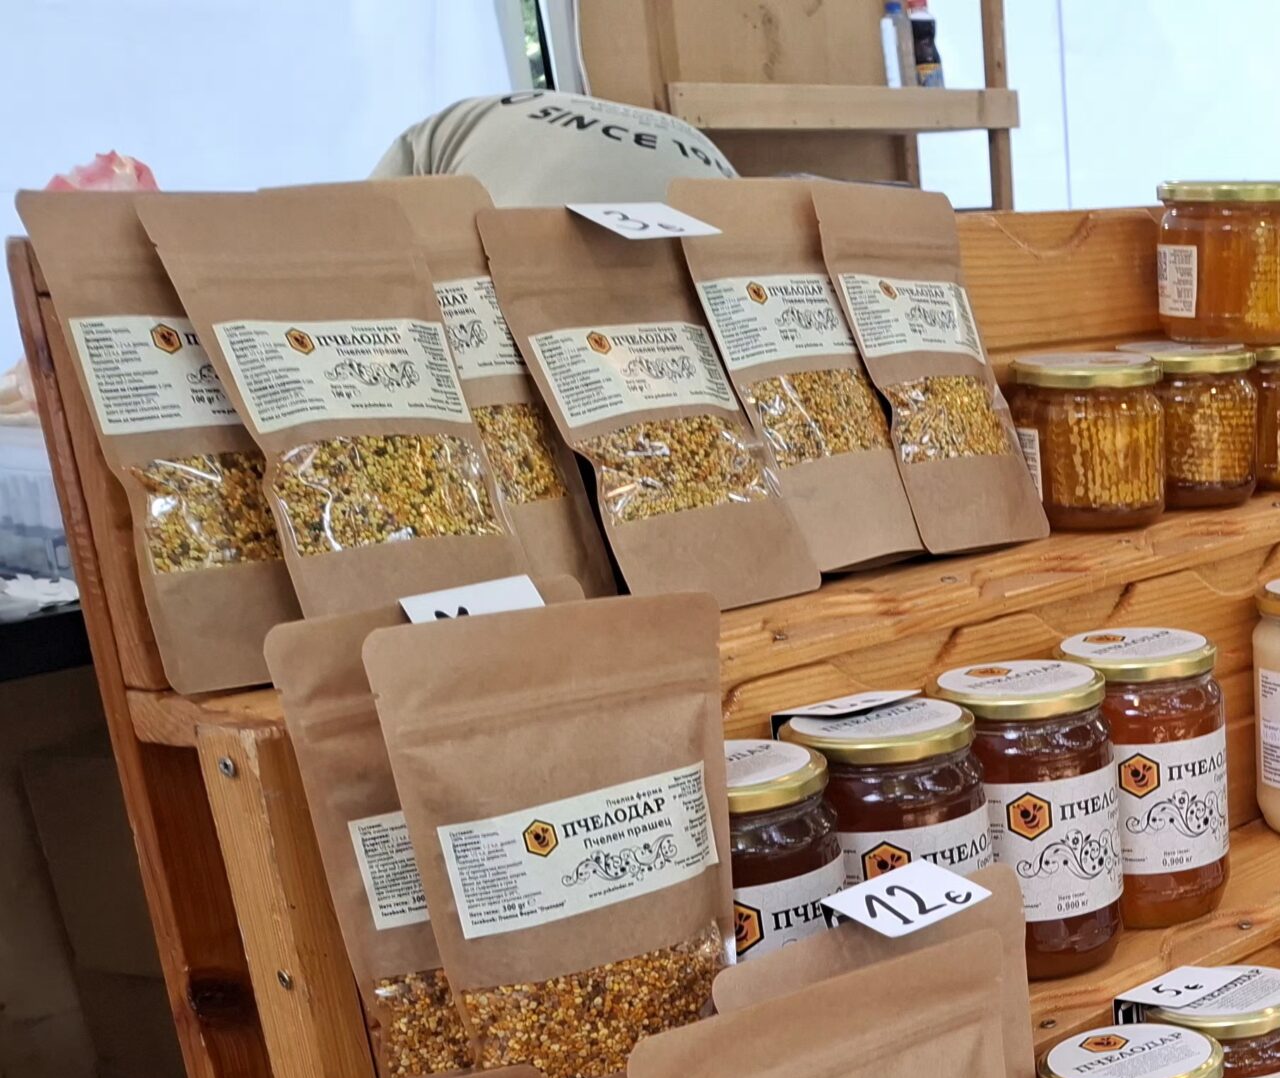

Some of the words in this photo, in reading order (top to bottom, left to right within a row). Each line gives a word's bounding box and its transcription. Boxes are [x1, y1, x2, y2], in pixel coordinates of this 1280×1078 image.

[527, 105, 657, 150] SINCE
[768, 285, 824, 297] ПЧЕЛОДАР
[896, 286, 945, 299] ПЧЕЛОДАР
[315, 331, 402, 348] ПЧЕЛОДАР
[611, 333, 678, 347] ПЧЕЛОДАР
[1167, 751, 1226, 781] ПЧЕЛО
[605, 794, 635, 808] Пчелна
[636, 786, 664, 802] ферма
[1058, 785, 1118, 821] ПЧЕЛО
[561, 797, 667, 839] ПЧЕЛОДАР
[583, 829, 626, 850] Пчелен
[627, 816, 673, 839] прашец
[920, 832, 990, 867] ПЧЕЛО
[864, 884, 972, 925] 12€
[1056, 901, 1080, 912] 0,900
[1073, 1030, 1183, 1076] ПЧЕЛОДАР
